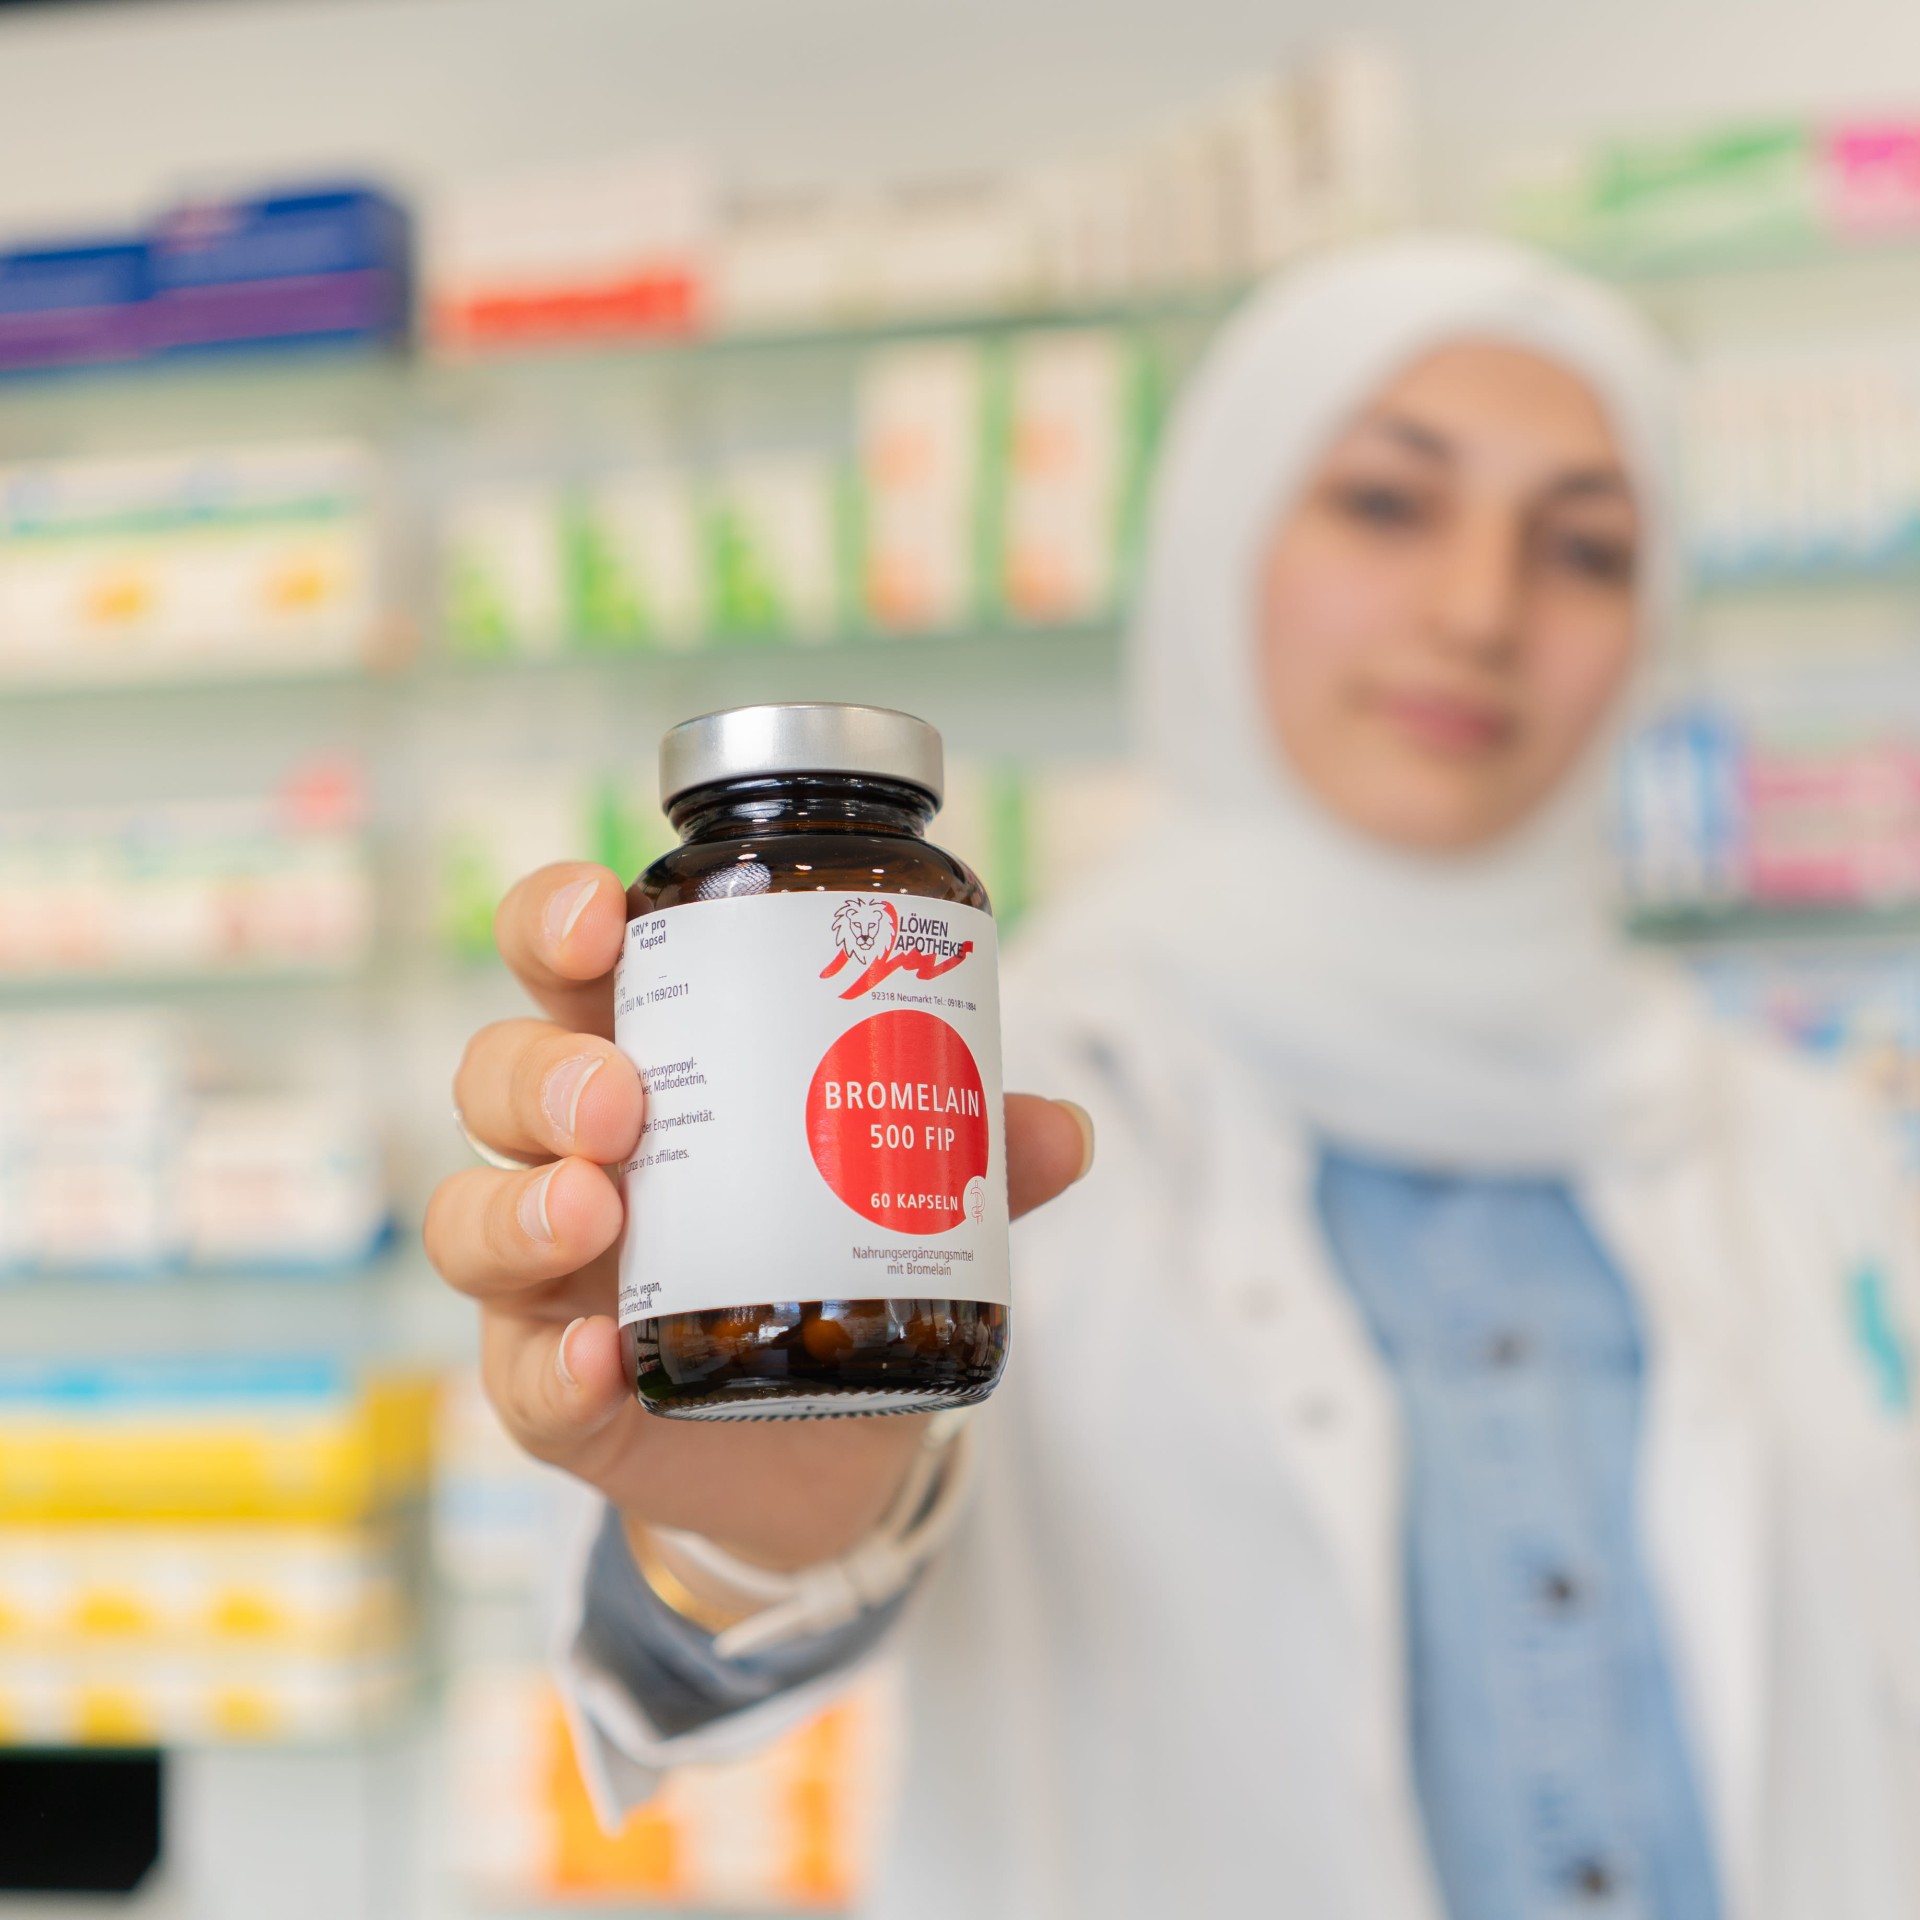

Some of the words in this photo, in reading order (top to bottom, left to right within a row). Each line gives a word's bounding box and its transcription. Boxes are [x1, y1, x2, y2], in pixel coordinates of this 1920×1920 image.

[651, 919, 666, 933] pro
[900, 913, 949, 937] LÖWEN
[640, 931, 666, 950] Kapsel
[895, 935, 963, 959] APOTHEKE
[636, 995, 645, 1008] Nr.
[646, 983, 689, 1004] 1169/2011
[871, 991, 895, 1001] 92318
[897, 993, 932, 1005] Neumarkt
[642, 1057, 697, 1083] Hydroxypropyl-
[654, 1072, 707, 1093] Maltodextrin,
[825, 1081, 980, 1118] BROMELAIN
[653, 1110, 715, 1131] Enzymaktivität.
[870, 1124, 915, 1150] 500
[925, 1126, 955, 1152] FIP
[646, 1154, 654, 1166] its
[655, 1148, 690, 1164] affiliates.
[871, 1193, 890, 1209] 60
[897, 1193, 958, 1211] KAPSELN
[852, 1246, 974, 1263] Nahrungsergänzungsmittel
[887, 1262, 904, 1275] mit
[907, 1262, 952, 1276] Bromelain
[640, 1281, 662, 1297] vegan,
